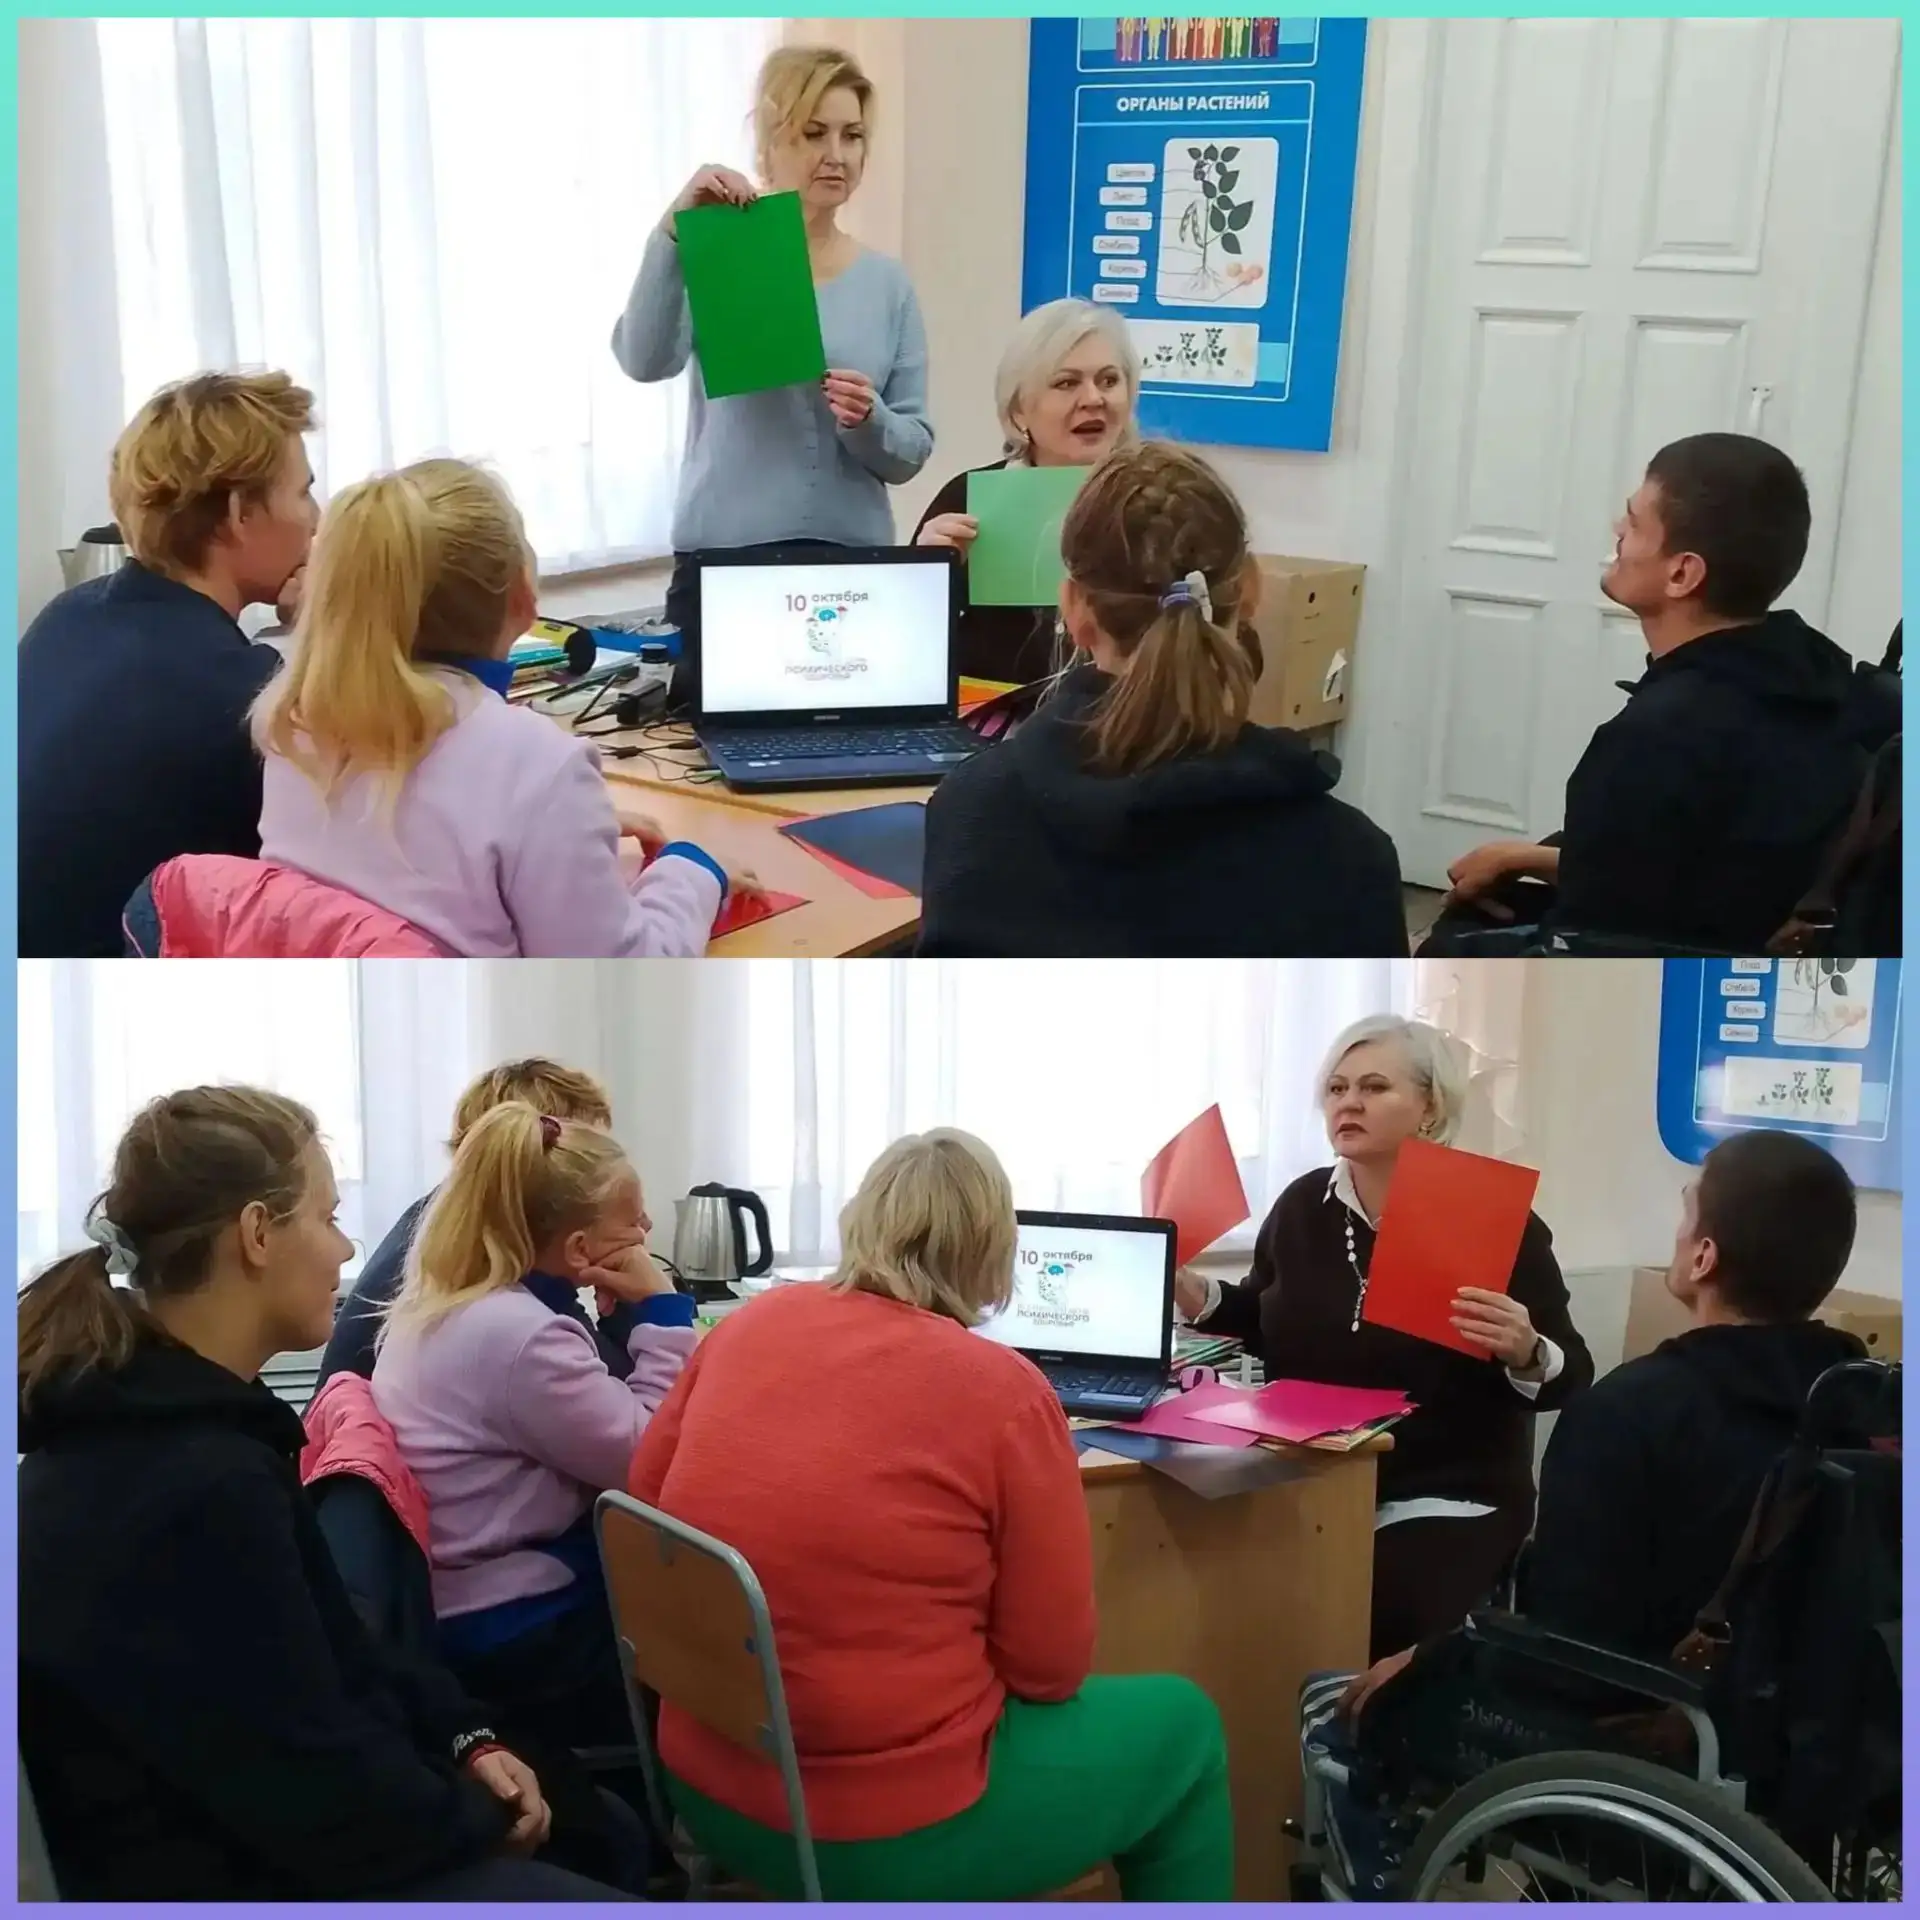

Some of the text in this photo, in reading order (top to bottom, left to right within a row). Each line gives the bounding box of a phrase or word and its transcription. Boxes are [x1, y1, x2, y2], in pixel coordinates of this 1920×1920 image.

[1116, 91, 1270, 112] ОРГАНЫ РАСТЕНИЙ
[784, 591, 869, 612] 10 октября
[1740, 959, 1761, 969] Плод
[1020, 1249, 1093, 1266] 10 октября
